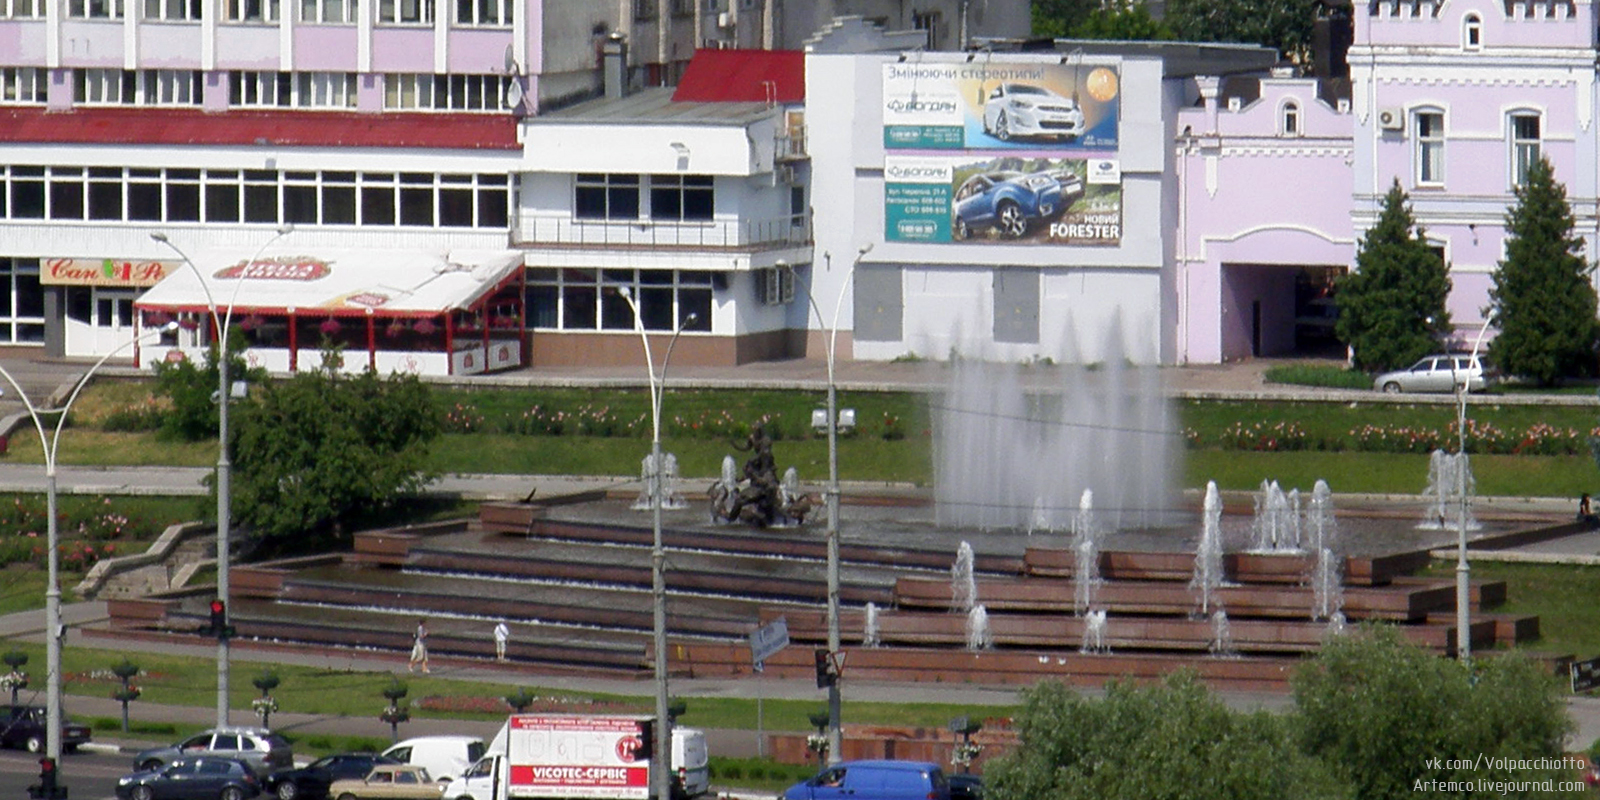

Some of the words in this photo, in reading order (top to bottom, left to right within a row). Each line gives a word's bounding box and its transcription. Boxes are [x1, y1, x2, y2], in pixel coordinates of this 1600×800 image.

[888, 66, 957, 80] Змінюючи
[961, 67, 1044, 81] стереотипи!
[1084, 213, 1119, 225] НОВИЙ
[1050, 223, 1119, 238] FORESTER
